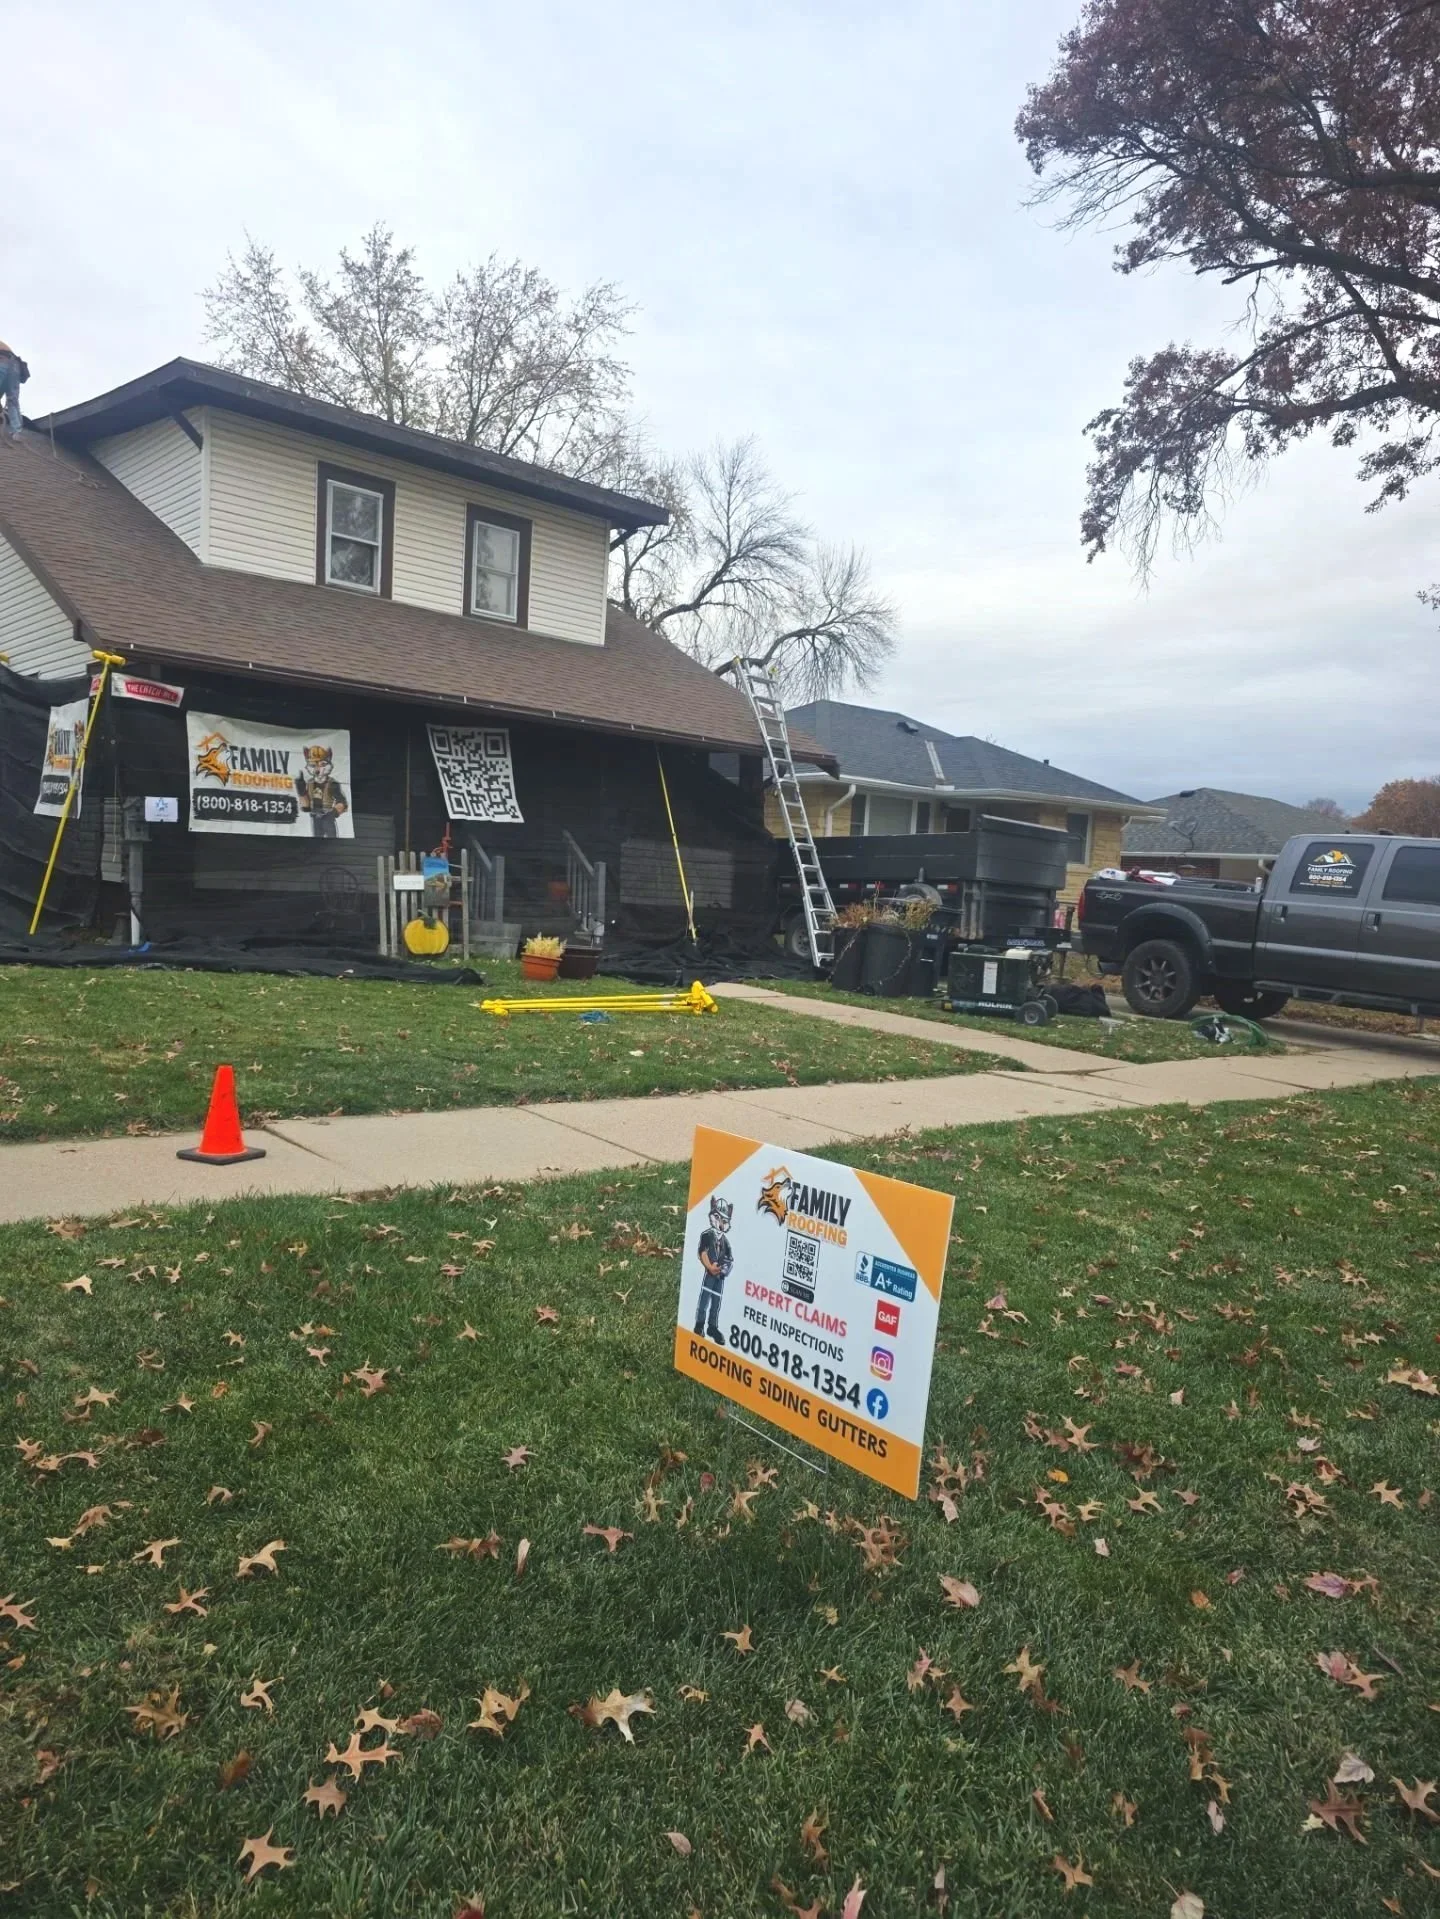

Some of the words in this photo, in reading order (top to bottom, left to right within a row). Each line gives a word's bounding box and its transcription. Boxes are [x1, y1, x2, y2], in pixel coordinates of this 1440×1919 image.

[229, 745, 290, 775] FAMILY
[231, 772, 293, 789] ROOFING
[196, 795, 293, 815] (800)-818-1354
[789, 1181, 852, 1227] FAMILY
[787, 1212, 848, 1246] ROOFING
[874, 1272, 893, 1290] A+
[892, 1284, 913, 1300] Rating
[744, 1279, 792, 1313] EXPERT
[794, 1302, 848, 1338] CLAIMS
[878, 1310, 898, 1326] GAF
[743, 1305, 767, 1328] FREE
[769, 1317, 845, 1362] INSPECTIONS
[728, 1324, 861, 1410] 800-818-1354
[690, 1340, 753, 1388] ROOFING
[759, 1376, 811, 1419] SIDING
[817, 1408, 888, 1459] GUTTERS
